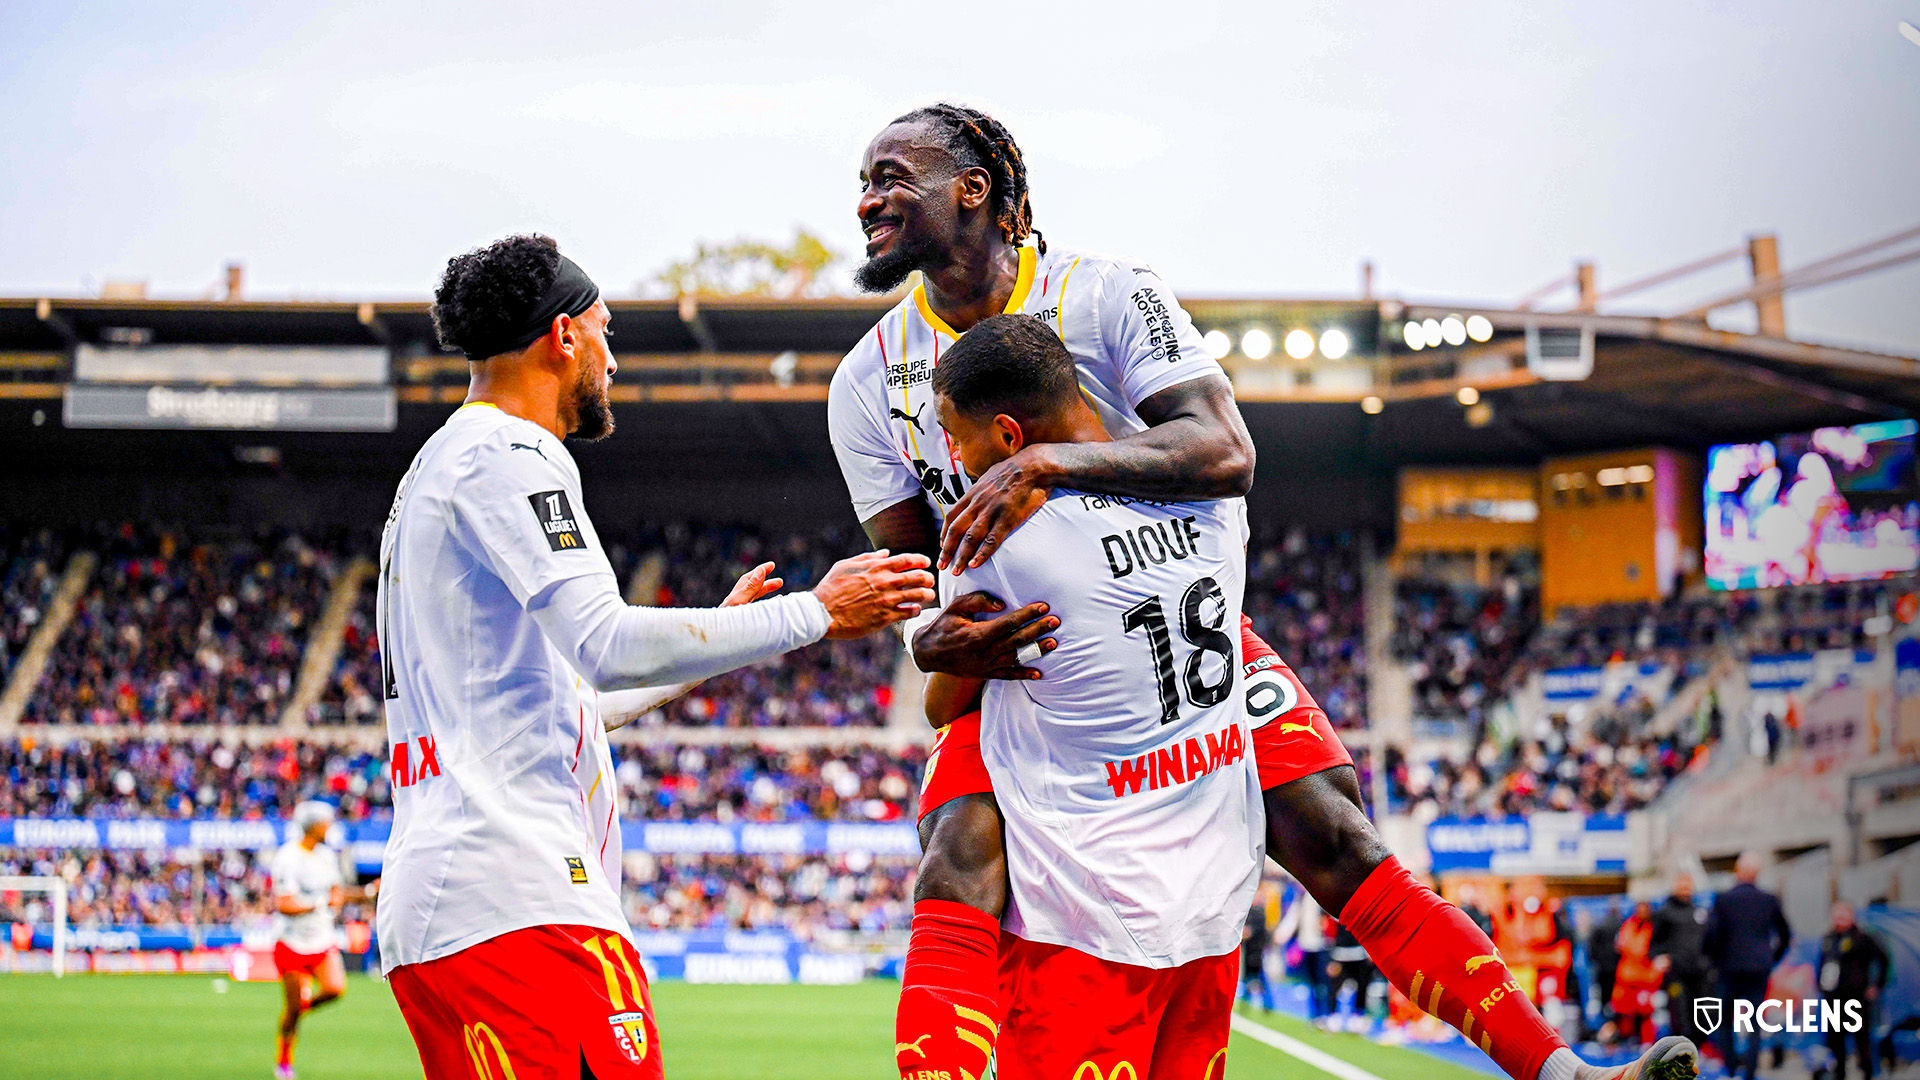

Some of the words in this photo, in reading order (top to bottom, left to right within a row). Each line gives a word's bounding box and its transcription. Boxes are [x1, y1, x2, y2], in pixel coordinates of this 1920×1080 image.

[1101, 515, 1200, 579] DIOUF
[1121, 576, 1234, 726] 18
[1105, 722, 1247, 798] WINAMA
[581, 933, 646, 1011] 11
[1480, 987, 1505, 1013] RC
